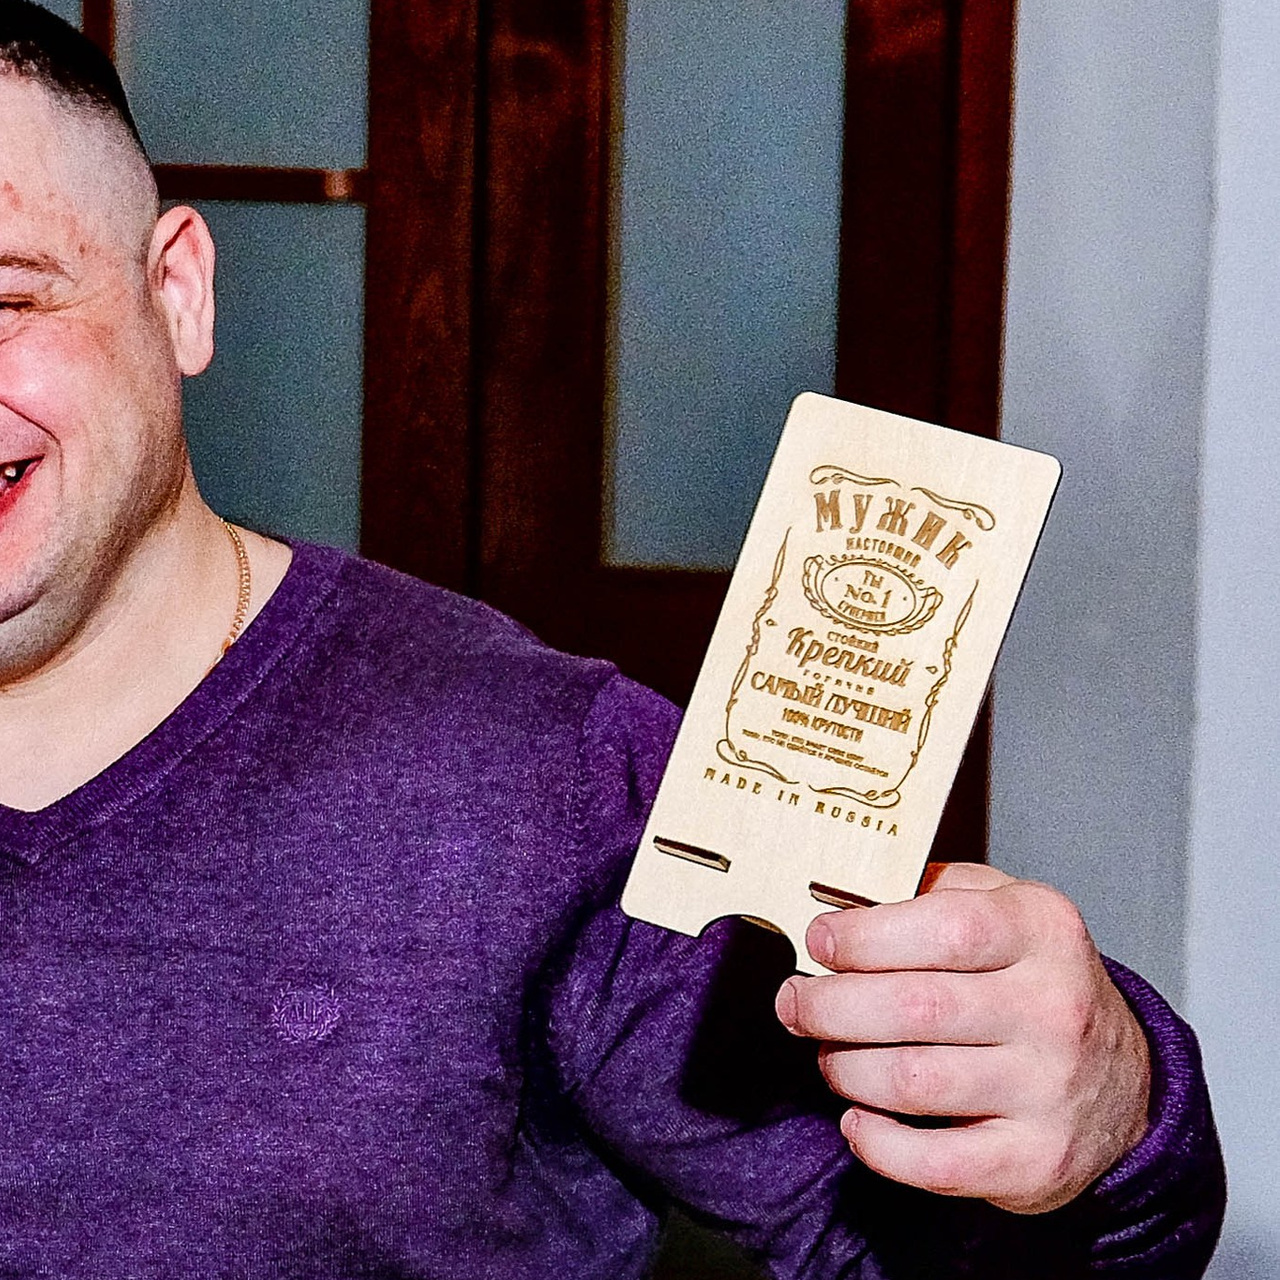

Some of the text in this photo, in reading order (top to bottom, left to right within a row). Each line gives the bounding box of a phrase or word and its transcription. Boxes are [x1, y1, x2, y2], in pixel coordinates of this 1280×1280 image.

[814, 489, 973, 570] МУЖИК
[786, 627, 914, 688] Крепкий
[751, 671, 913, 734] САМЫЙ ЛУЧШИЙ
[704, 768, 898, 836] MADE IN RUSSIA
